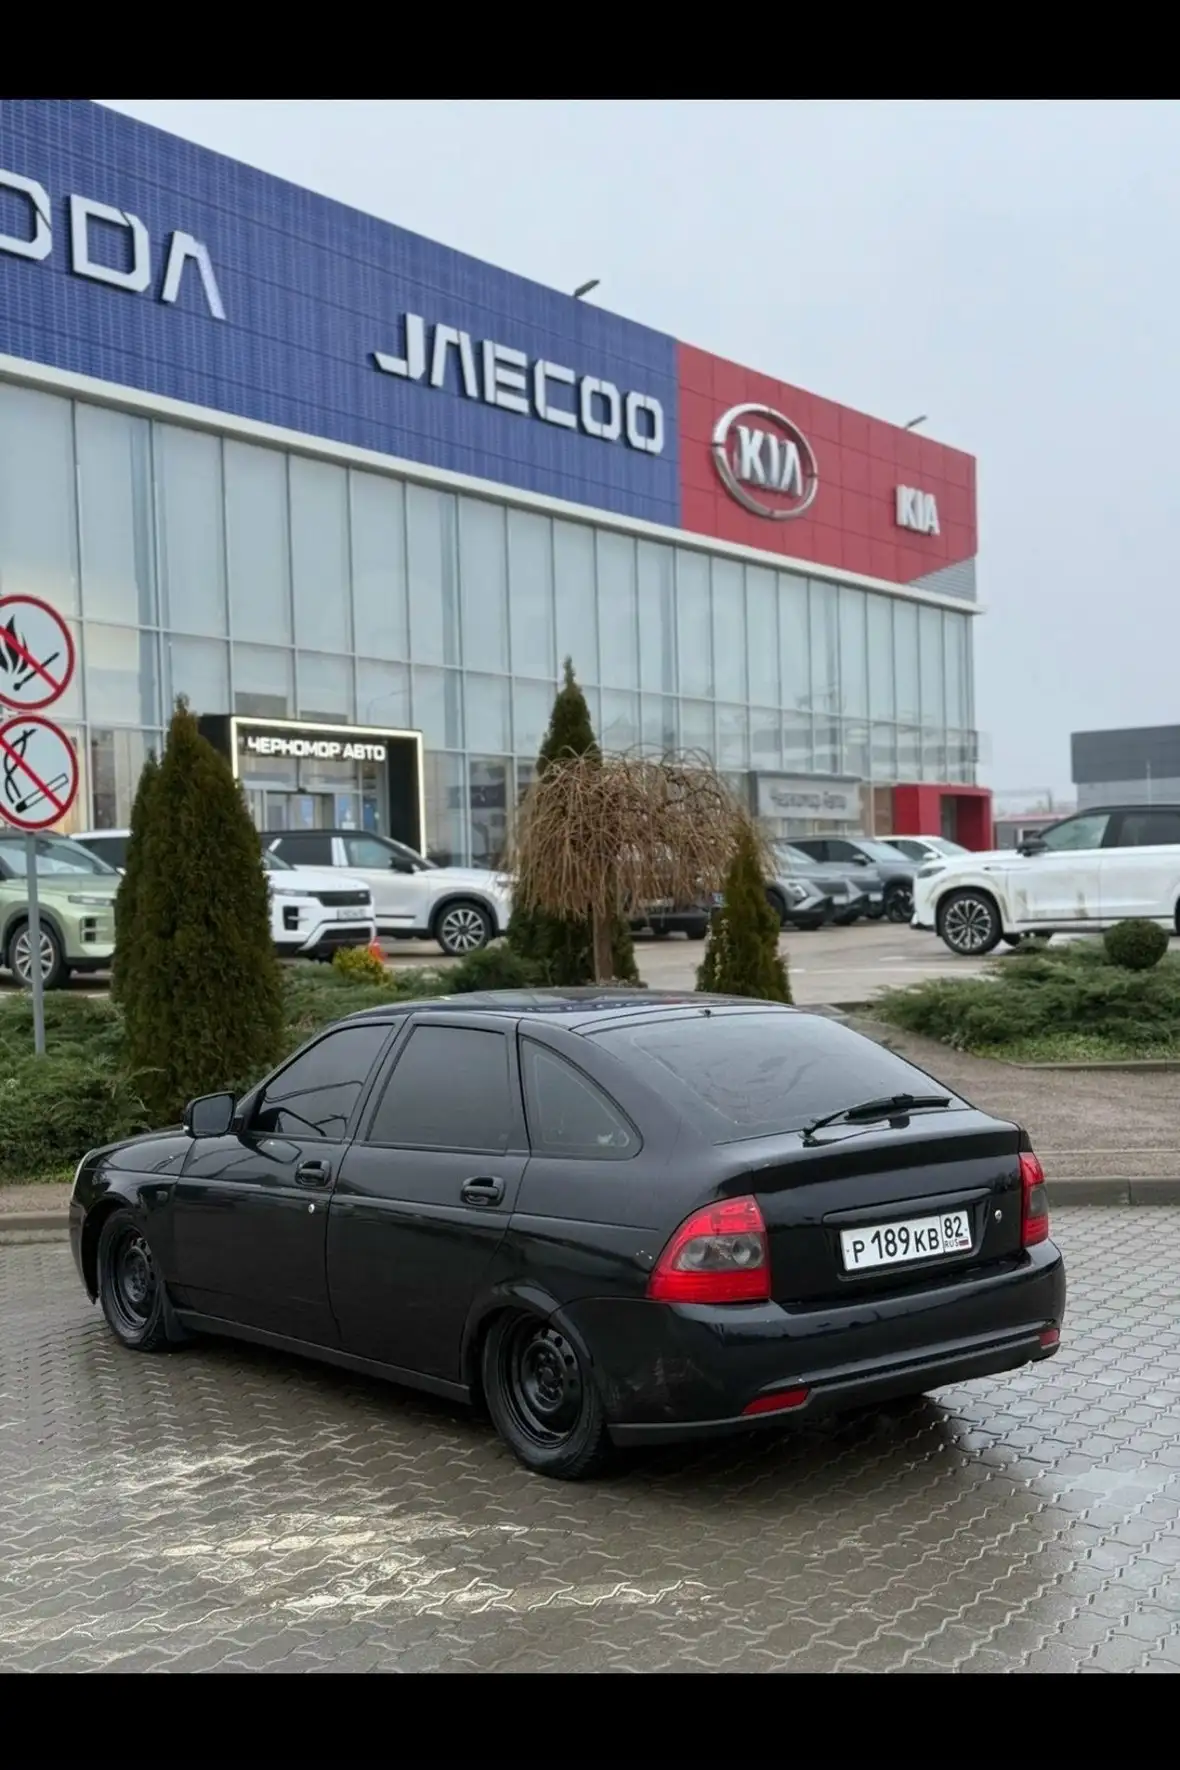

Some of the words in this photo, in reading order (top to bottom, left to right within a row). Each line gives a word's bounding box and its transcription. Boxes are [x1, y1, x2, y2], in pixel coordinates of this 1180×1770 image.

[373, 312, 664, 455] JAECOO
[736, 425, 803, 497] KIA
[897, 484, 940, 536] KIA
[248, 736, 340, 758] ЧЕРНОМОР
[343, 743, 386, 761] АВТО
[944, 1215, 963, 1239] 82
[944, 1238, 959, 1248] RUS
